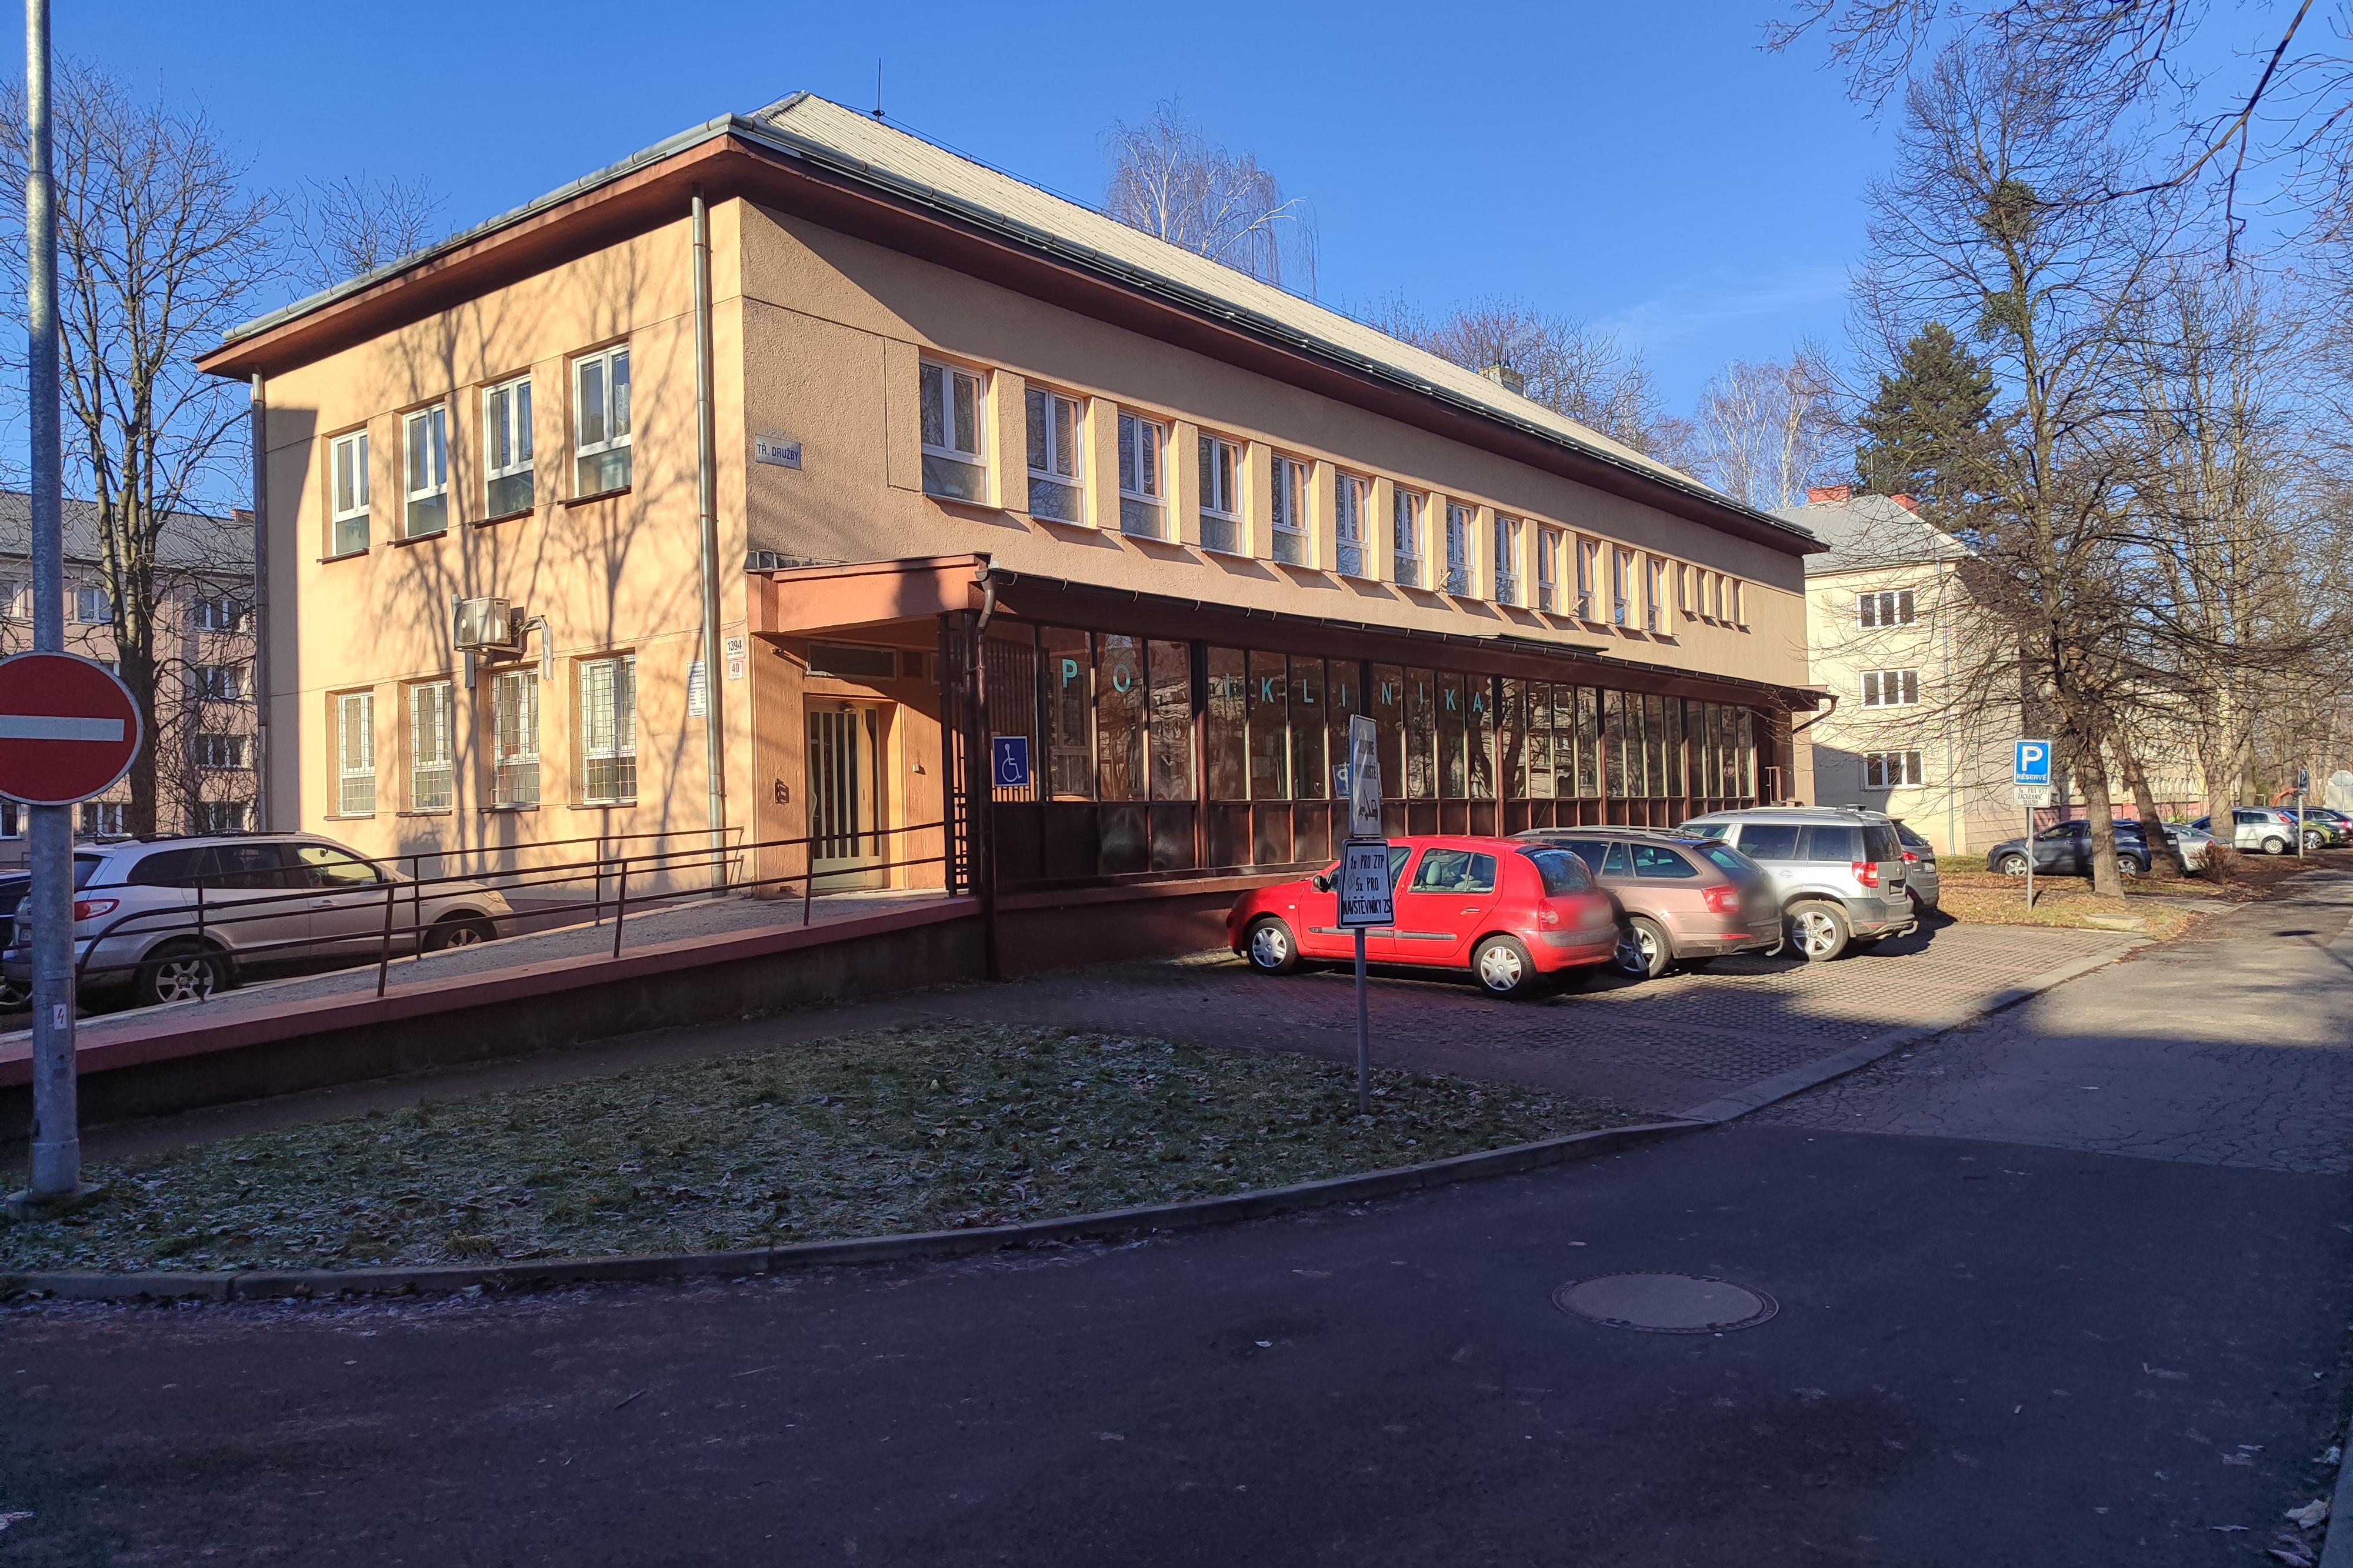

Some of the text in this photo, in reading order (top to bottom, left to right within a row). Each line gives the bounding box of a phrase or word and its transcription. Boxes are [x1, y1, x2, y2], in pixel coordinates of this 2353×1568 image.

[757, 442, 799, 461] TŘ. DRUŽBY
[727, 639, 742, 651] 1394
[732, 662, 739, 673] 40
[2021, 745, 2043, 772] P
[2017, 772, 2047, 781] RÉSERVÉ
[1351, 854, 1384, 870] 1x PRO ZTP
[1355, 877, 1379, 892] 5x PRO
[1342, 896, 1382, 915] NÁVŠTĚVNÍKY
